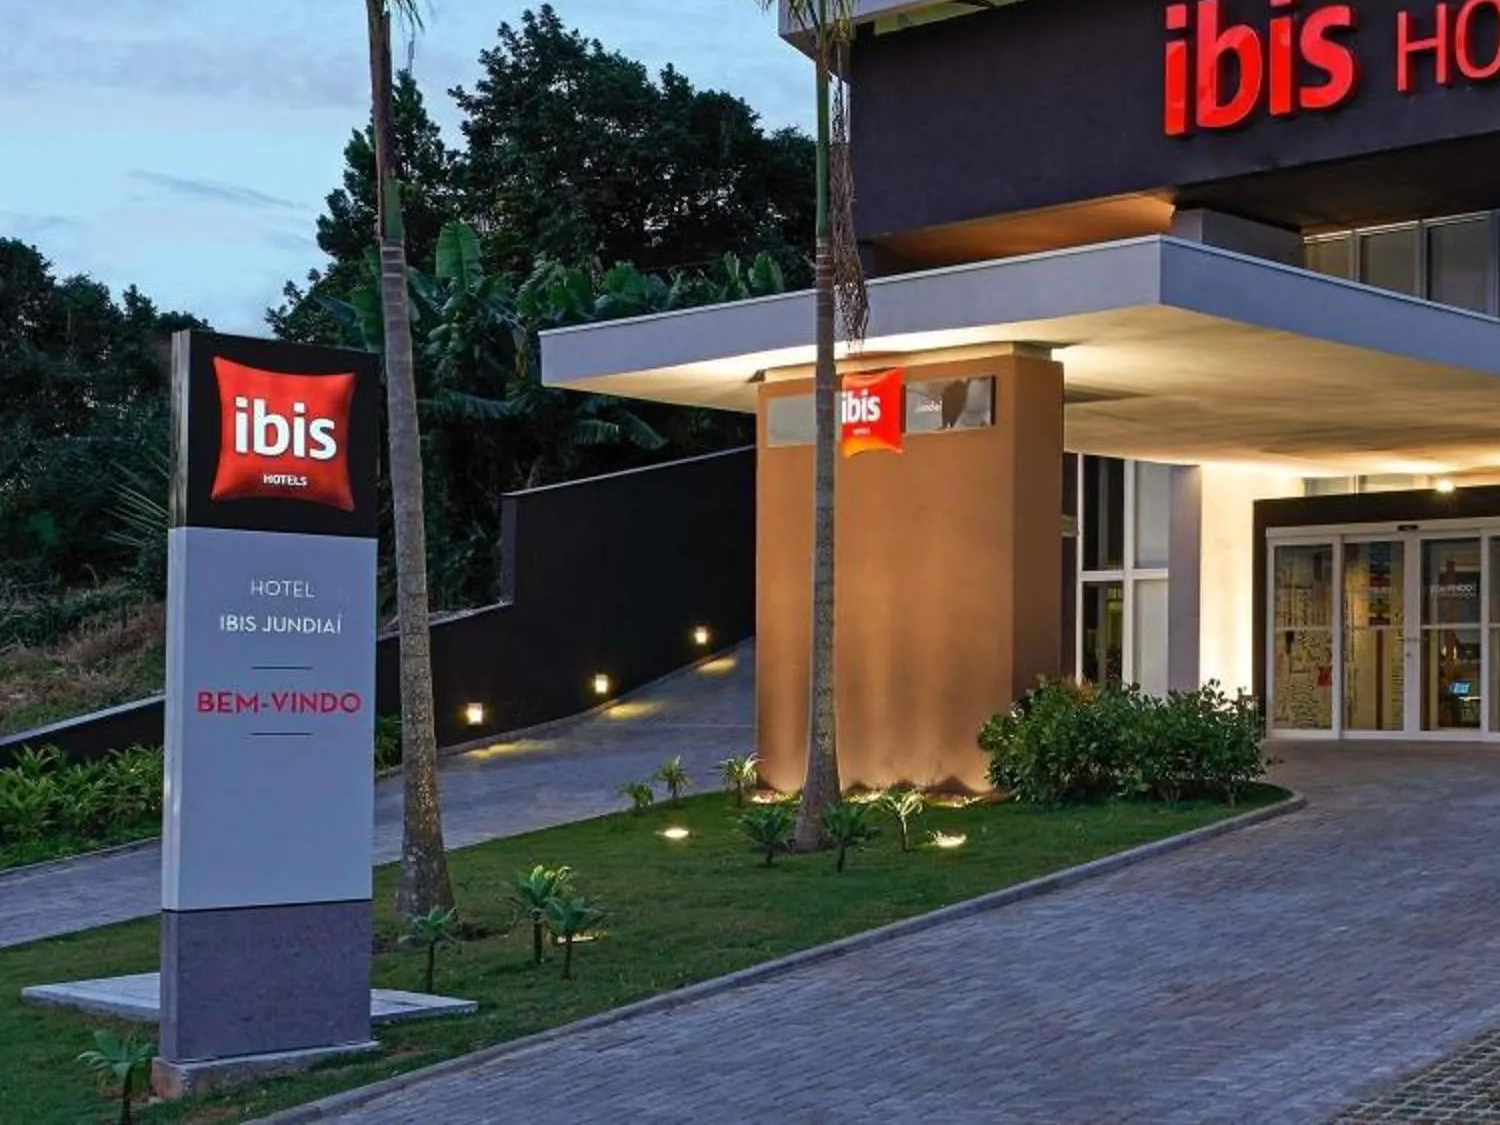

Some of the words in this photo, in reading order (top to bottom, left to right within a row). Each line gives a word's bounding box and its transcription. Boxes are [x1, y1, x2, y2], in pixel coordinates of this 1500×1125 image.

[841, 388, 882, 424] ibis
[235, 396, 337, 460] ibis
[263, 474, 308, 486] HOTELS
[250, 579, 315, 598] HOTEL
[219, 614, 257, 633] IBIS
[262, 613, 342, 634] JUNDIAÍ
[196, 690, 361, 714] BEM-VINDO
